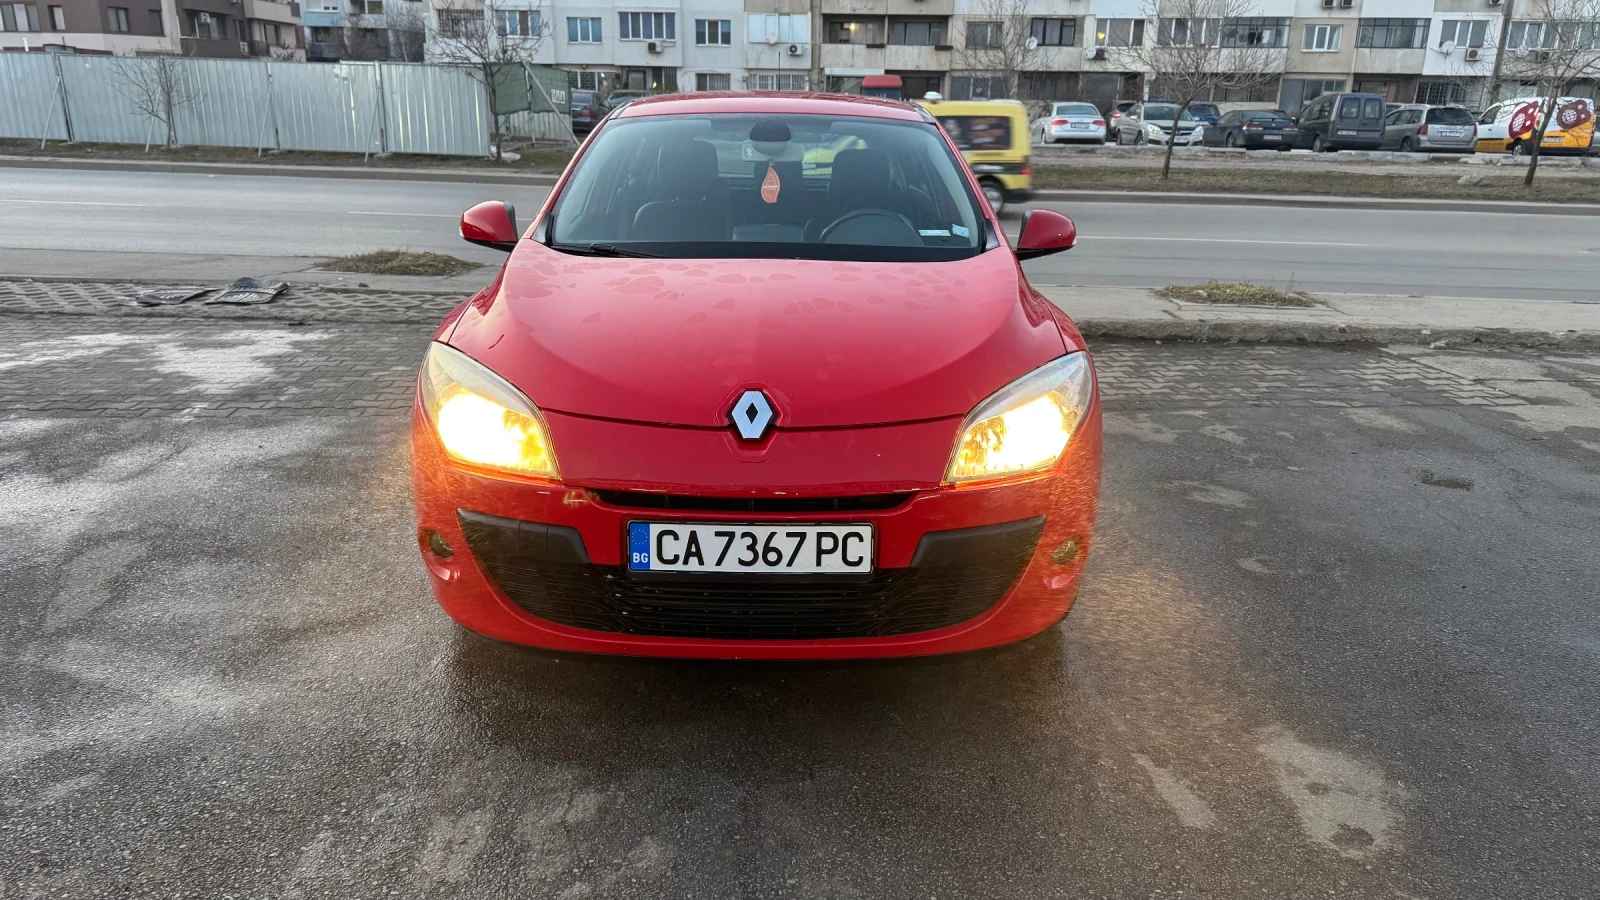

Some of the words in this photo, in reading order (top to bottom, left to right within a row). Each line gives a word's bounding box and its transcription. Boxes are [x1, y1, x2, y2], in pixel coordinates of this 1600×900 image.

[632, 553, 649, 564] BG
[656, 530, 704, 566] CA
[714, 531, 807, 567] 7367
[815, 531, 864, 567] PC
